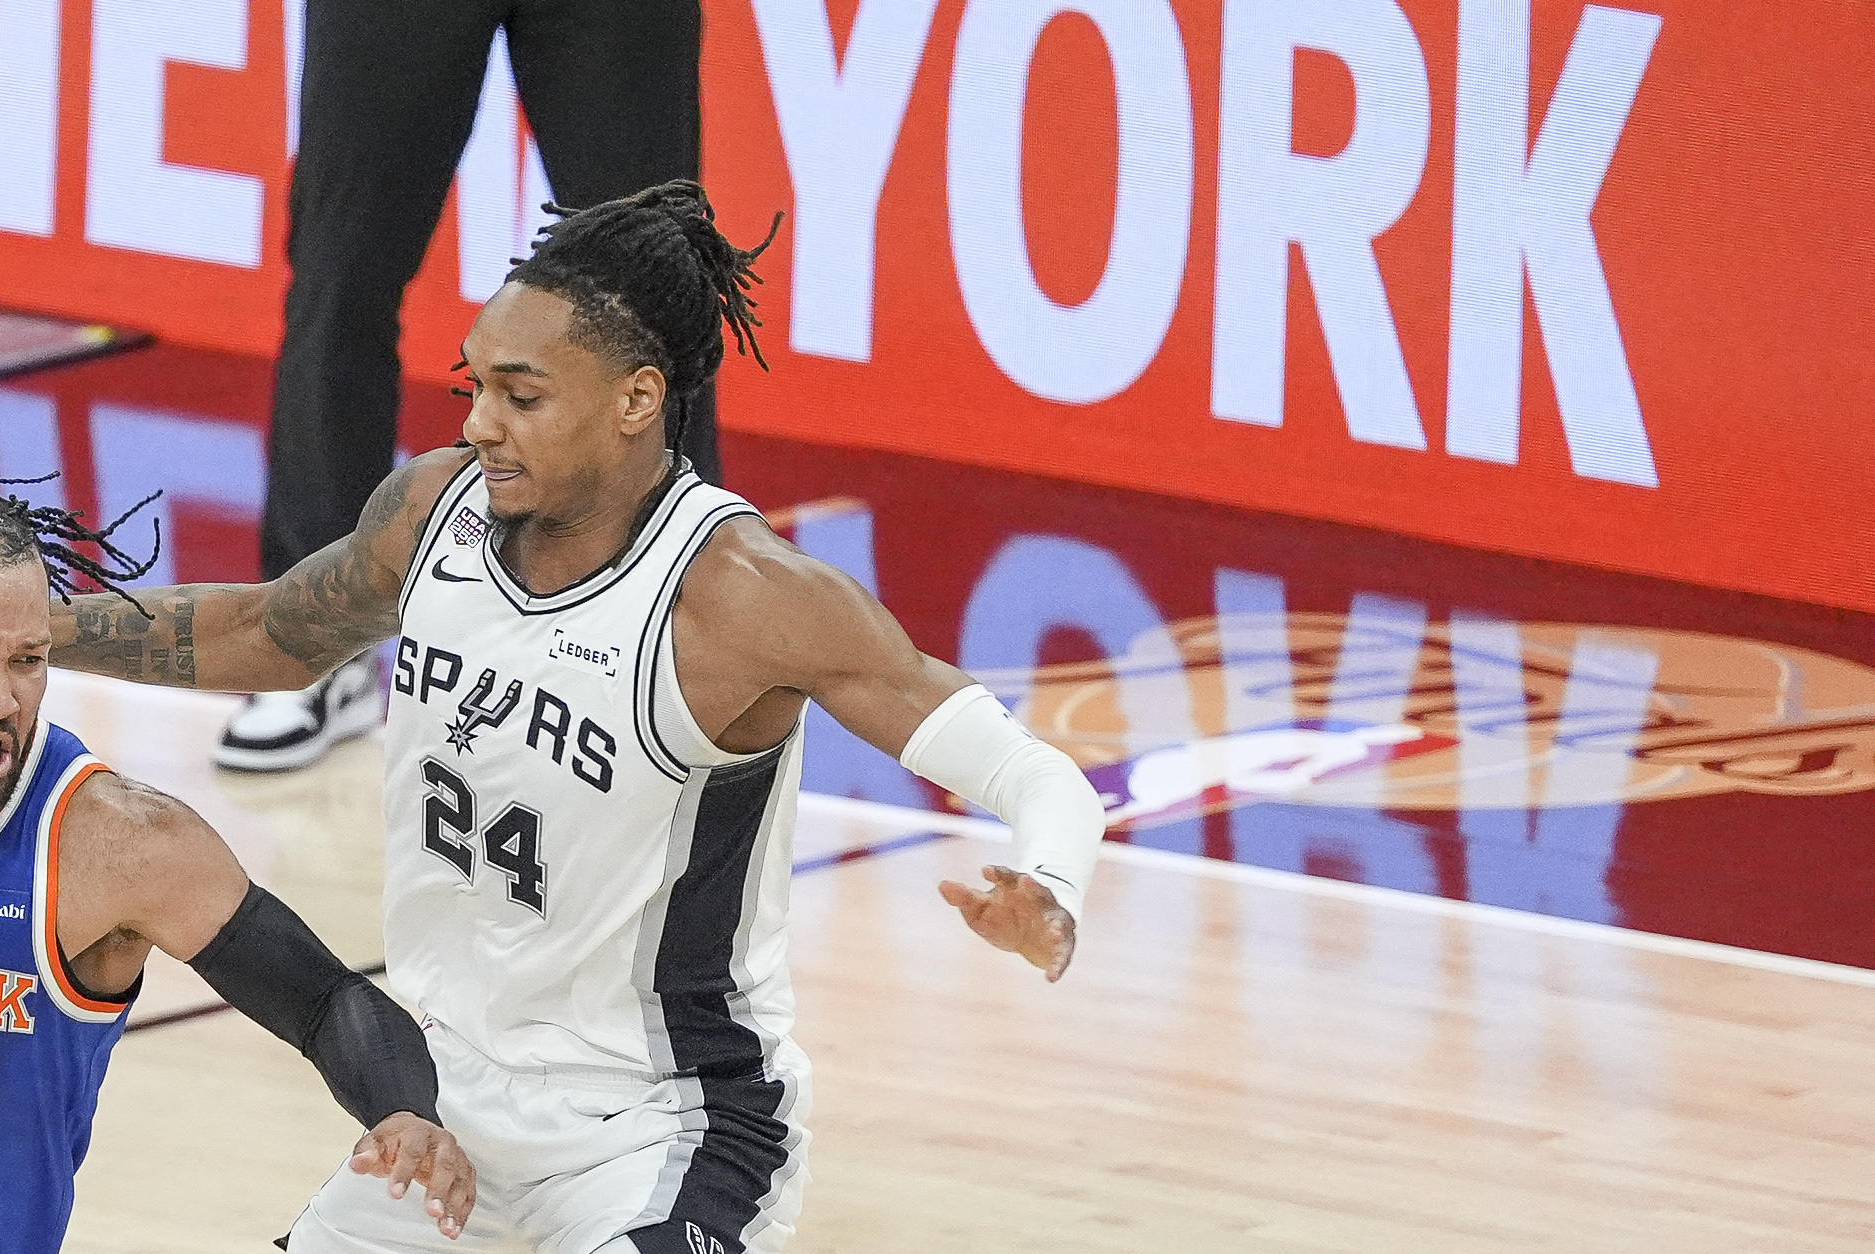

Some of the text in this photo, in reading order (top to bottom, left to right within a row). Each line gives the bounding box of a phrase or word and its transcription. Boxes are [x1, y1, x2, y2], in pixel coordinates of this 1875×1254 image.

[751, 0, 1664, 488] YORK
[448, 521, 479, 548] 250
[461, 509, 486, 534] USA
[558, 639, 609, 667] LEDGER
[395, 635, 616, 794] SPURS
[419, 754, 547, 920] 24
